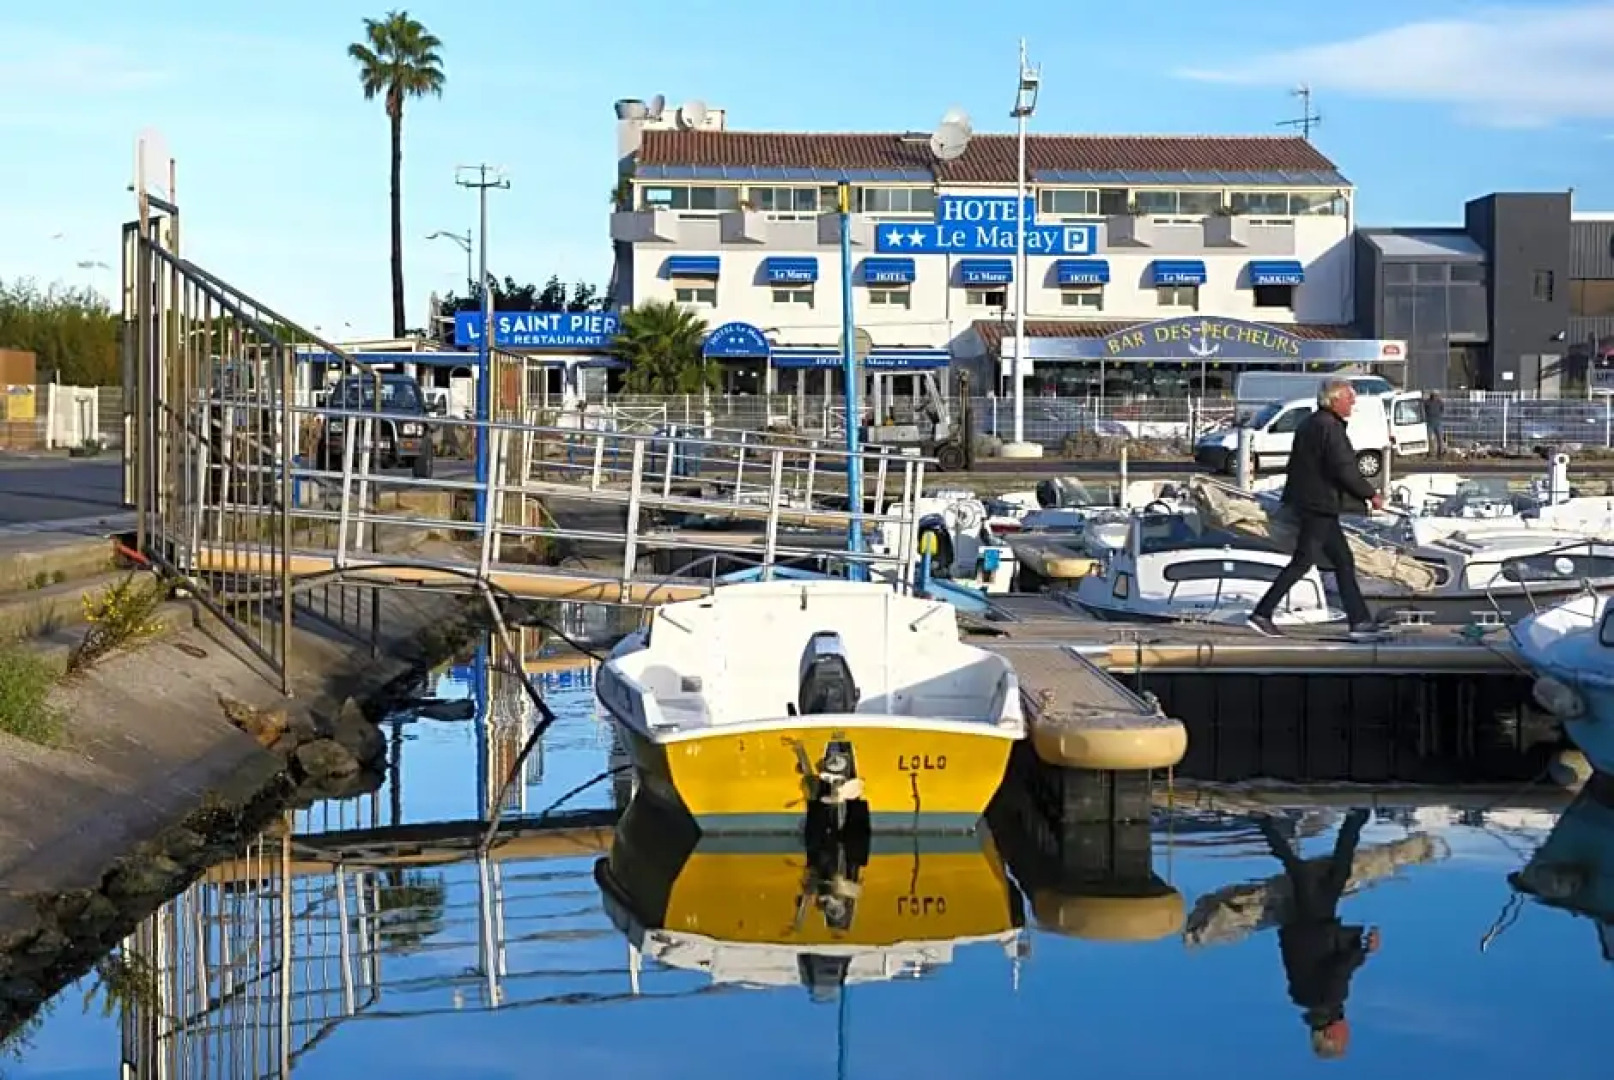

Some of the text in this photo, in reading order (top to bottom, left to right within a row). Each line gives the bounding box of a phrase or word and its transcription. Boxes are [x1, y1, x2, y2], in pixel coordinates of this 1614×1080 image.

[943, 199, 1031, 221] HOTEL
[935, 226, 966, 248] Le
[876, 272, 906, 281] HOTEL
[969, 273, 981, 281] Le
[1070, 274, 1100, 283] HOTEL
[1163, 274, 1174, 282] Le
[1258, 275, 1299, 284] PARKING
[500, 315, 562, 334] SAINT
[514, 334, 602, 344] RESTAURANT
[1106, 334, 1147, 355] BAR
[1154, 323, 1192, 342] DES
[898, 754, 947, 771] LOLO
